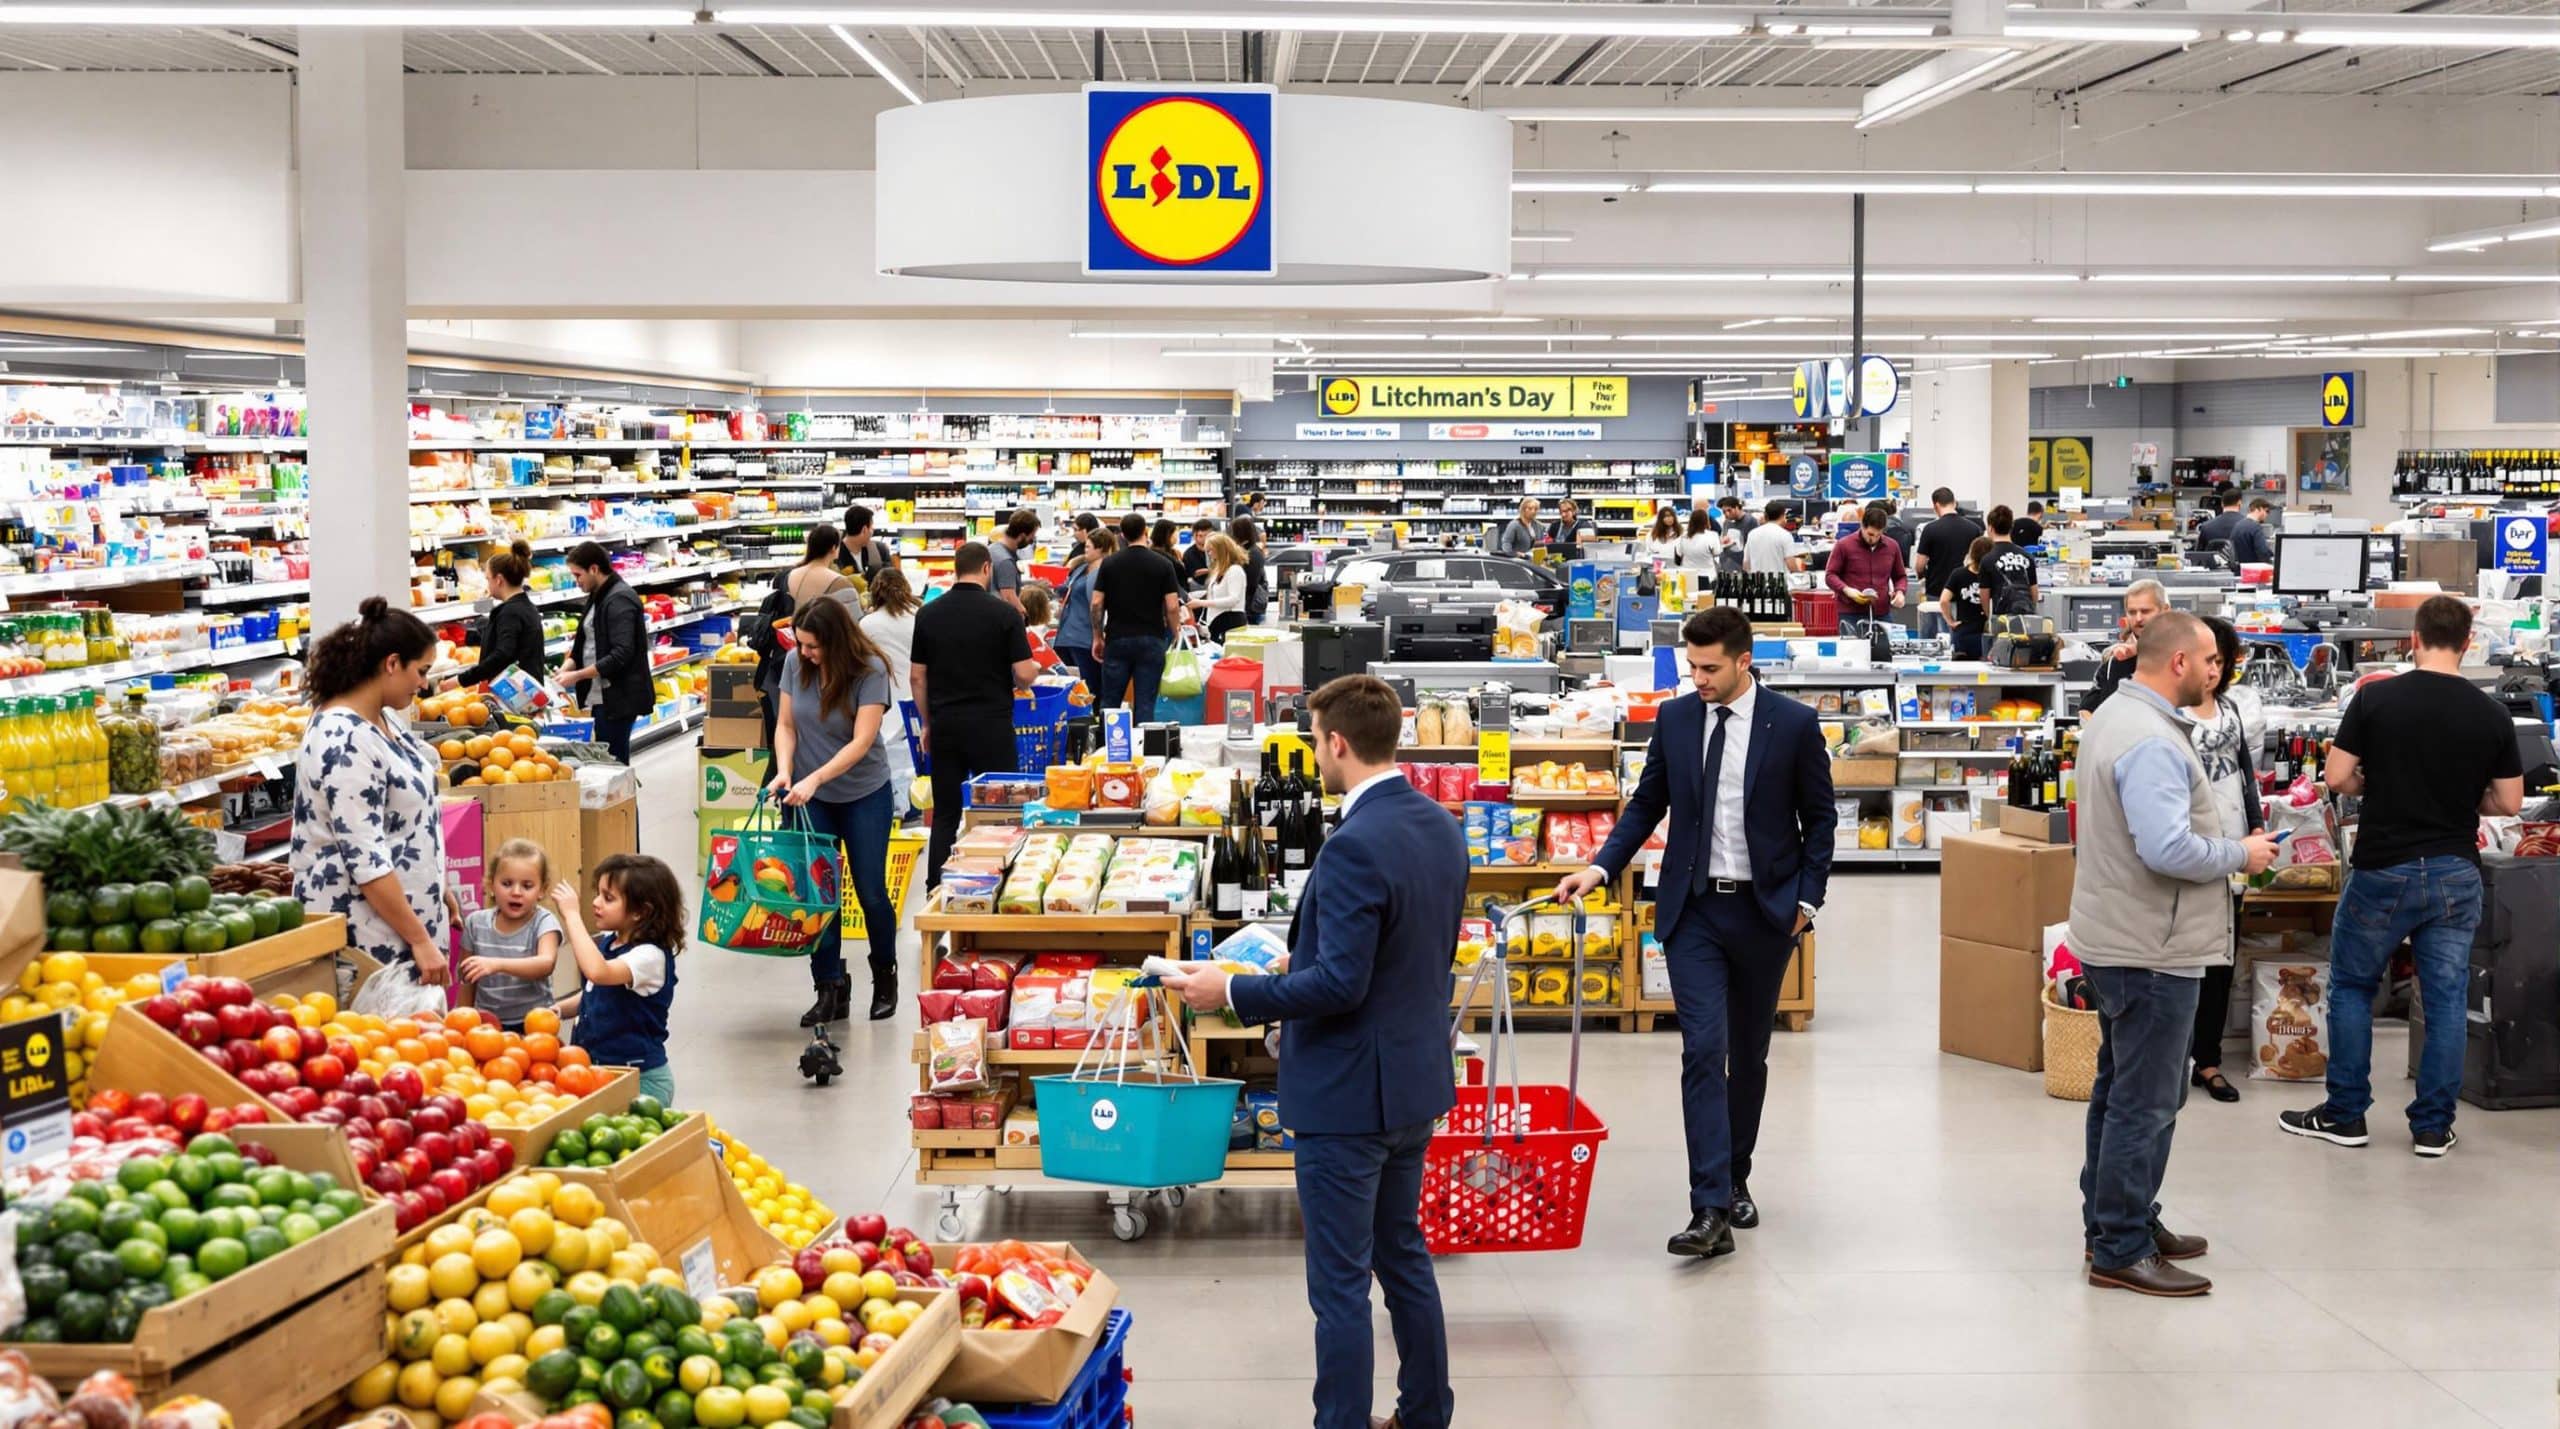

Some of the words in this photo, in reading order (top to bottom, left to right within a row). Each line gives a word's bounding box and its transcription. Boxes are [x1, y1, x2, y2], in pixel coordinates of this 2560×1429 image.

[1112, 145, 1251, 207] LIDL
[1371, 385, 1502, 407] Litchman's
[1508, 385, 1555, 412] Day
